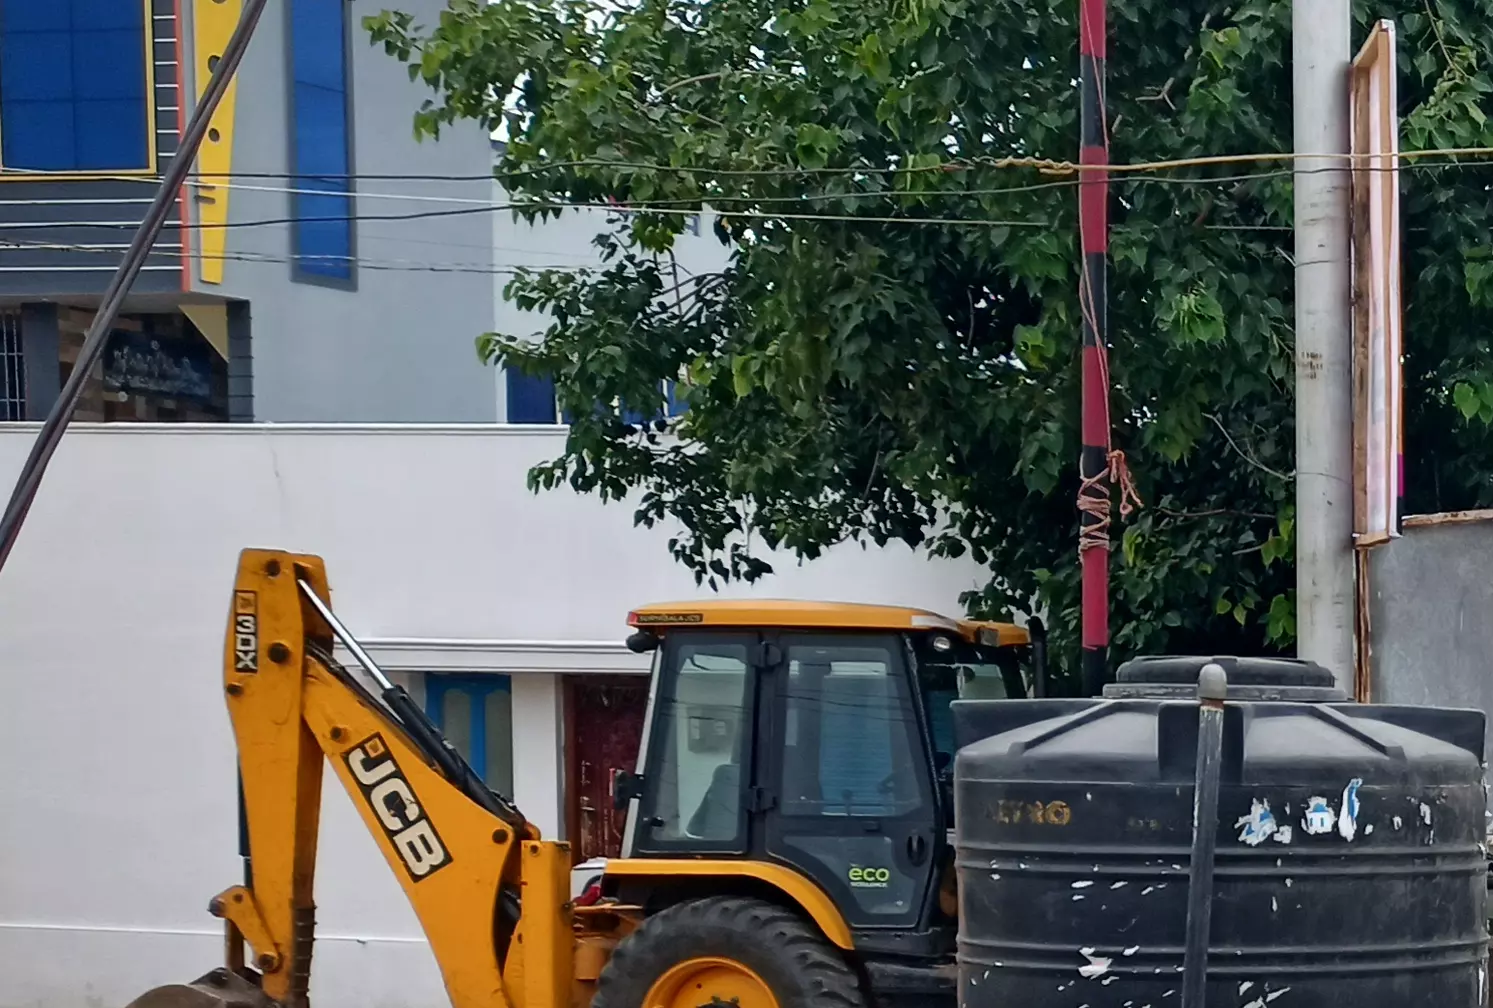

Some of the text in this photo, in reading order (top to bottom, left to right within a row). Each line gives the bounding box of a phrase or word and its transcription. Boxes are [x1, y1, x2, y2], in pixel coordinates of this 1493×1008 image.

[235, 615, 258, 670] 3DX
[347, 745, 445, 876] JCB
[848, 867, 890, 882] eco
